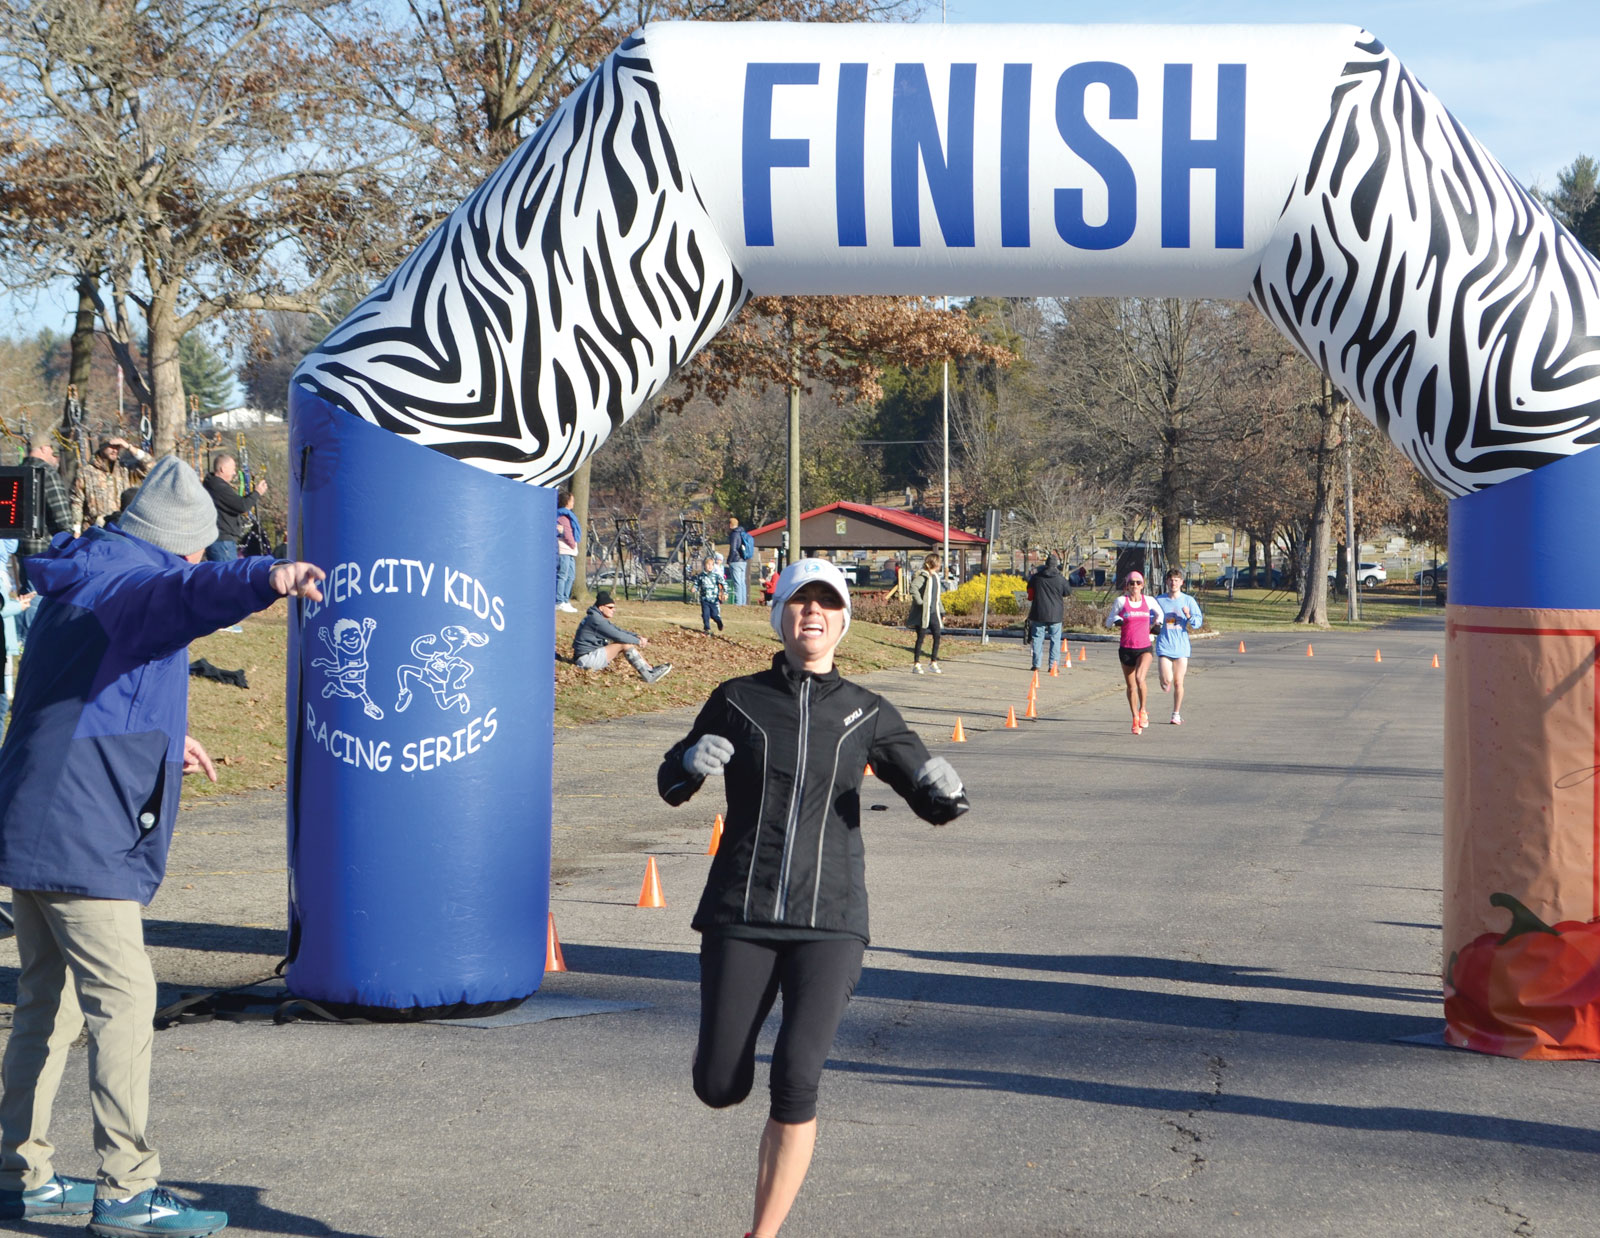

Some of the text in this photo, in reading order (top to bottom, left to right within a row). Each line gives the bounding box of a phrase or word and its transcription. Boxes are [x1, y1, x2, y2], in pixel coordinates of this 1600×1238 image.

[742, 61, 1247, 251] FINISH
[369, 558, 435, 597] CITY
[444, 566, 505, 631] KIDS
[306, 702, 498, 772] RACING SERIES
